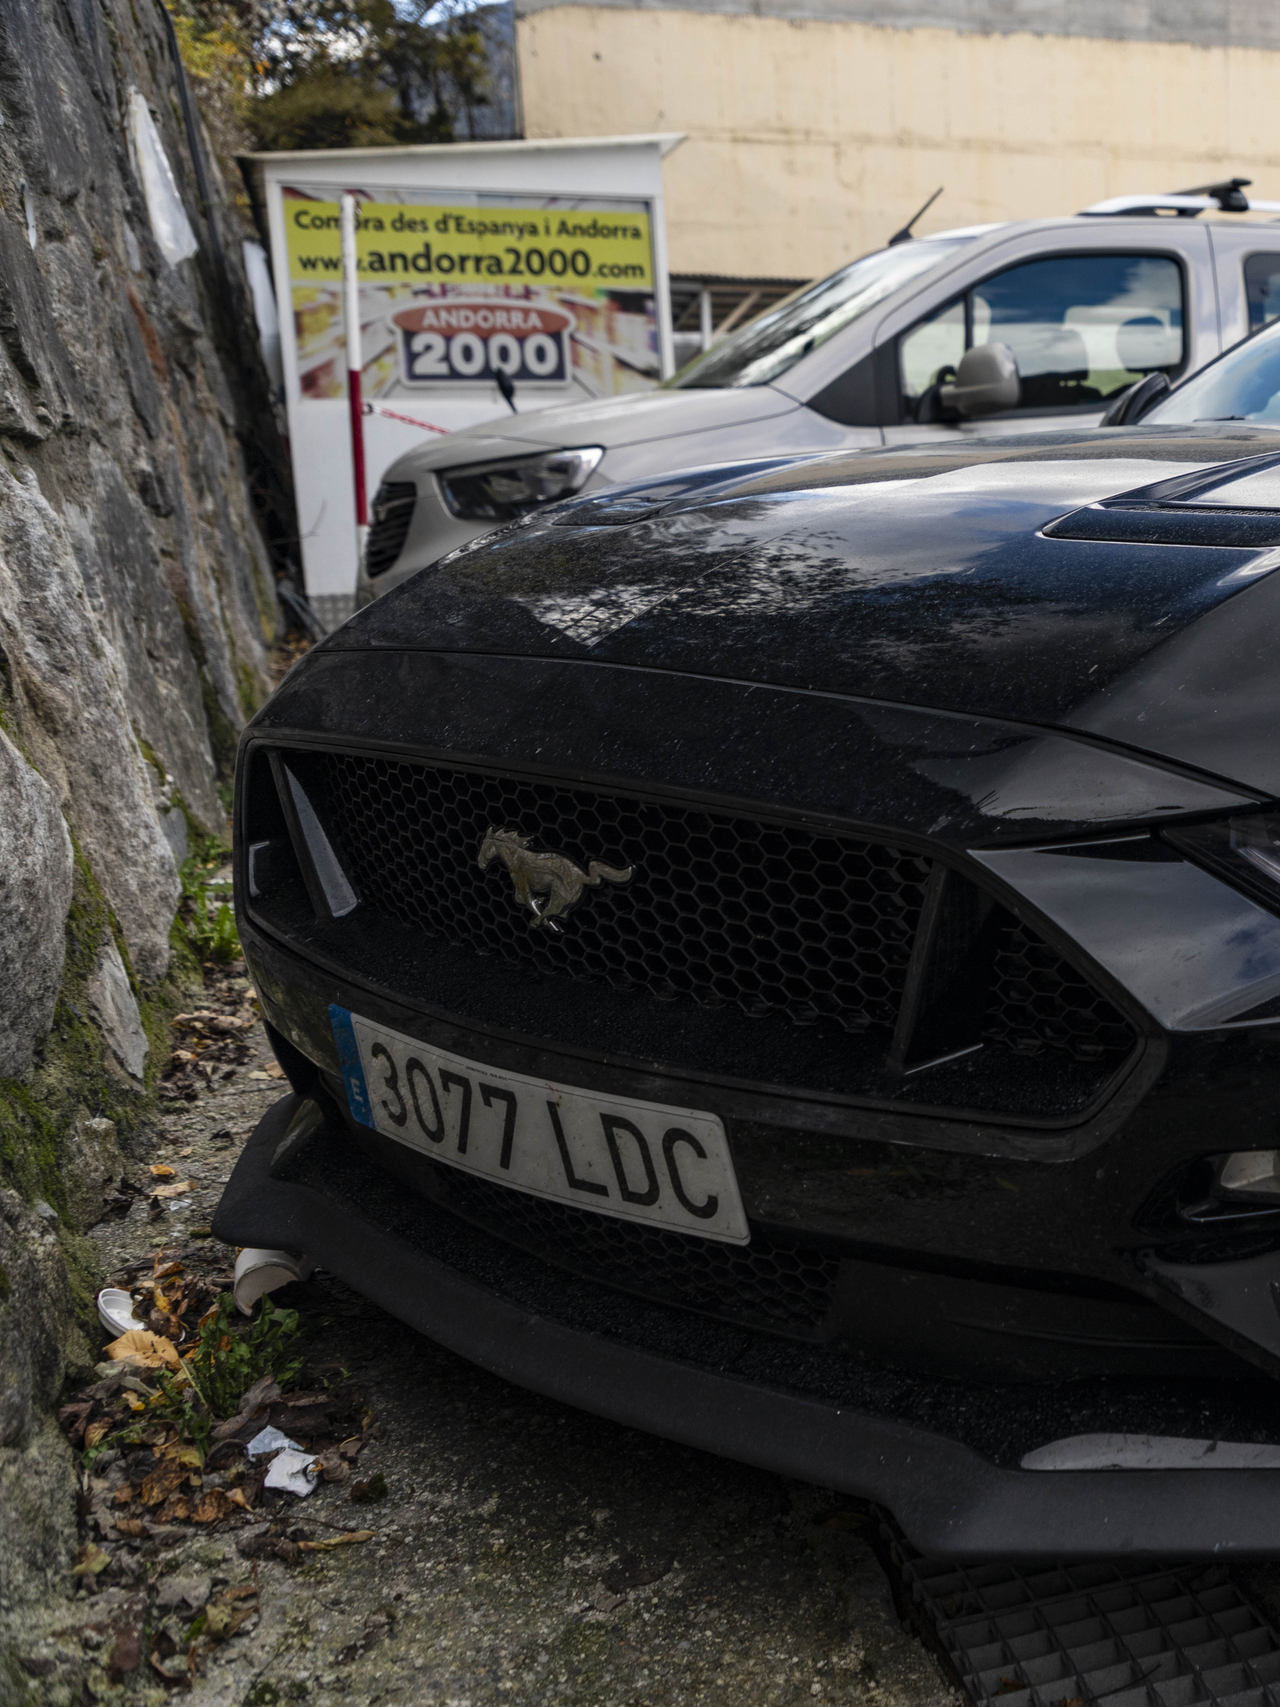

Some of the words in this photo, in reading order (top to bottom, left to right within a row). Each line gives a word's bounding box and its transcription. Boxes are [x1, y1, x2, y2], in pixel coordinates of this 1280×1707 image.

[391, 211, 428, 232] des
[435, 211, 539, 241] d'Espanya
[544, 216, 551, 236] i
[557, 217, 642, 240] Andorra
[298, 241, 645, 277] ww.andorra2000.com
[422, 308, 542, 329] ANDORRA
[410, 331, 559, 377] 2000
[350, 1077, 364, 1103] E
[371, 1042, 518, 1171] 3077
[546, 1100, 719, 1219] LDC
